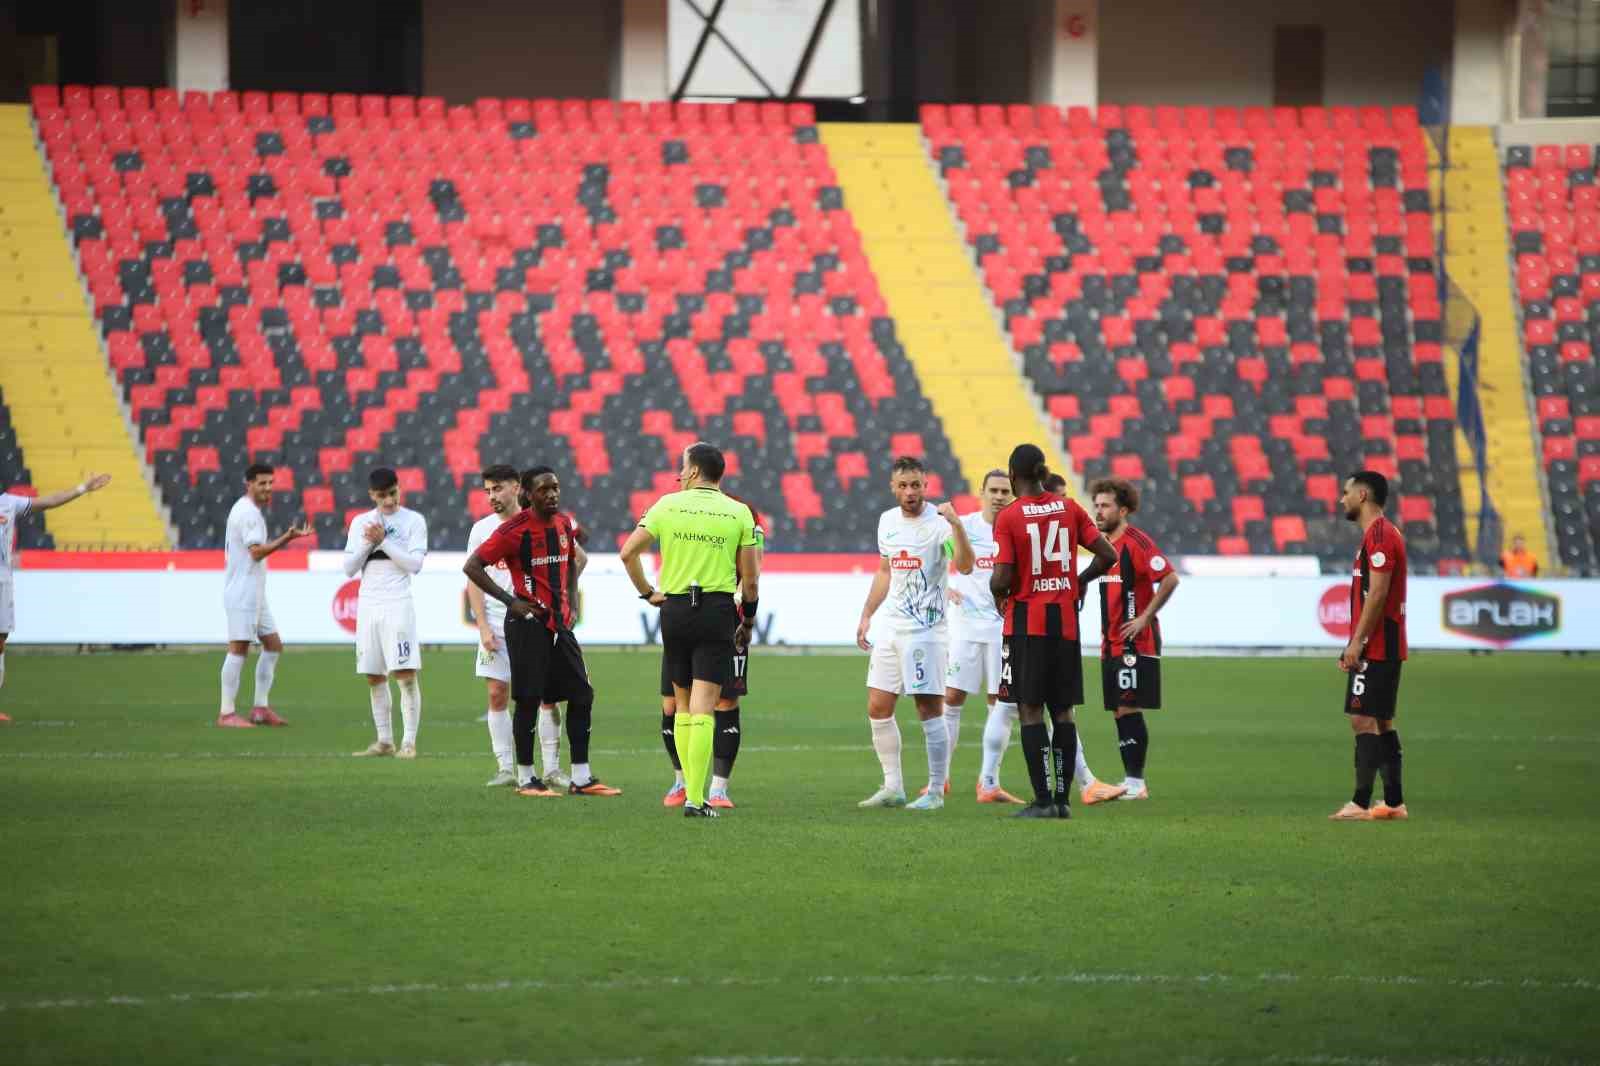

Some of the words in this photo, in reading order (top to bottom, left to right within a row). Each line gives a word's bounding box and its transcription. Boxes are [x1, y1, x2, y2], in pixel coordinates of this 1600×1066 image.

[673, 531, 724, 545] MAHMOOD
[1026, 520, 1072, 575] 14
[1032, 577, 1072, 592] ABENA
[397, 641, 410, 657] 18
[733, 655, 747, 678] 17
[915, 662, 925, 681] 5
[1118, 668, 1138, 690] 61
[1352, 674, 1366, 696] 6
